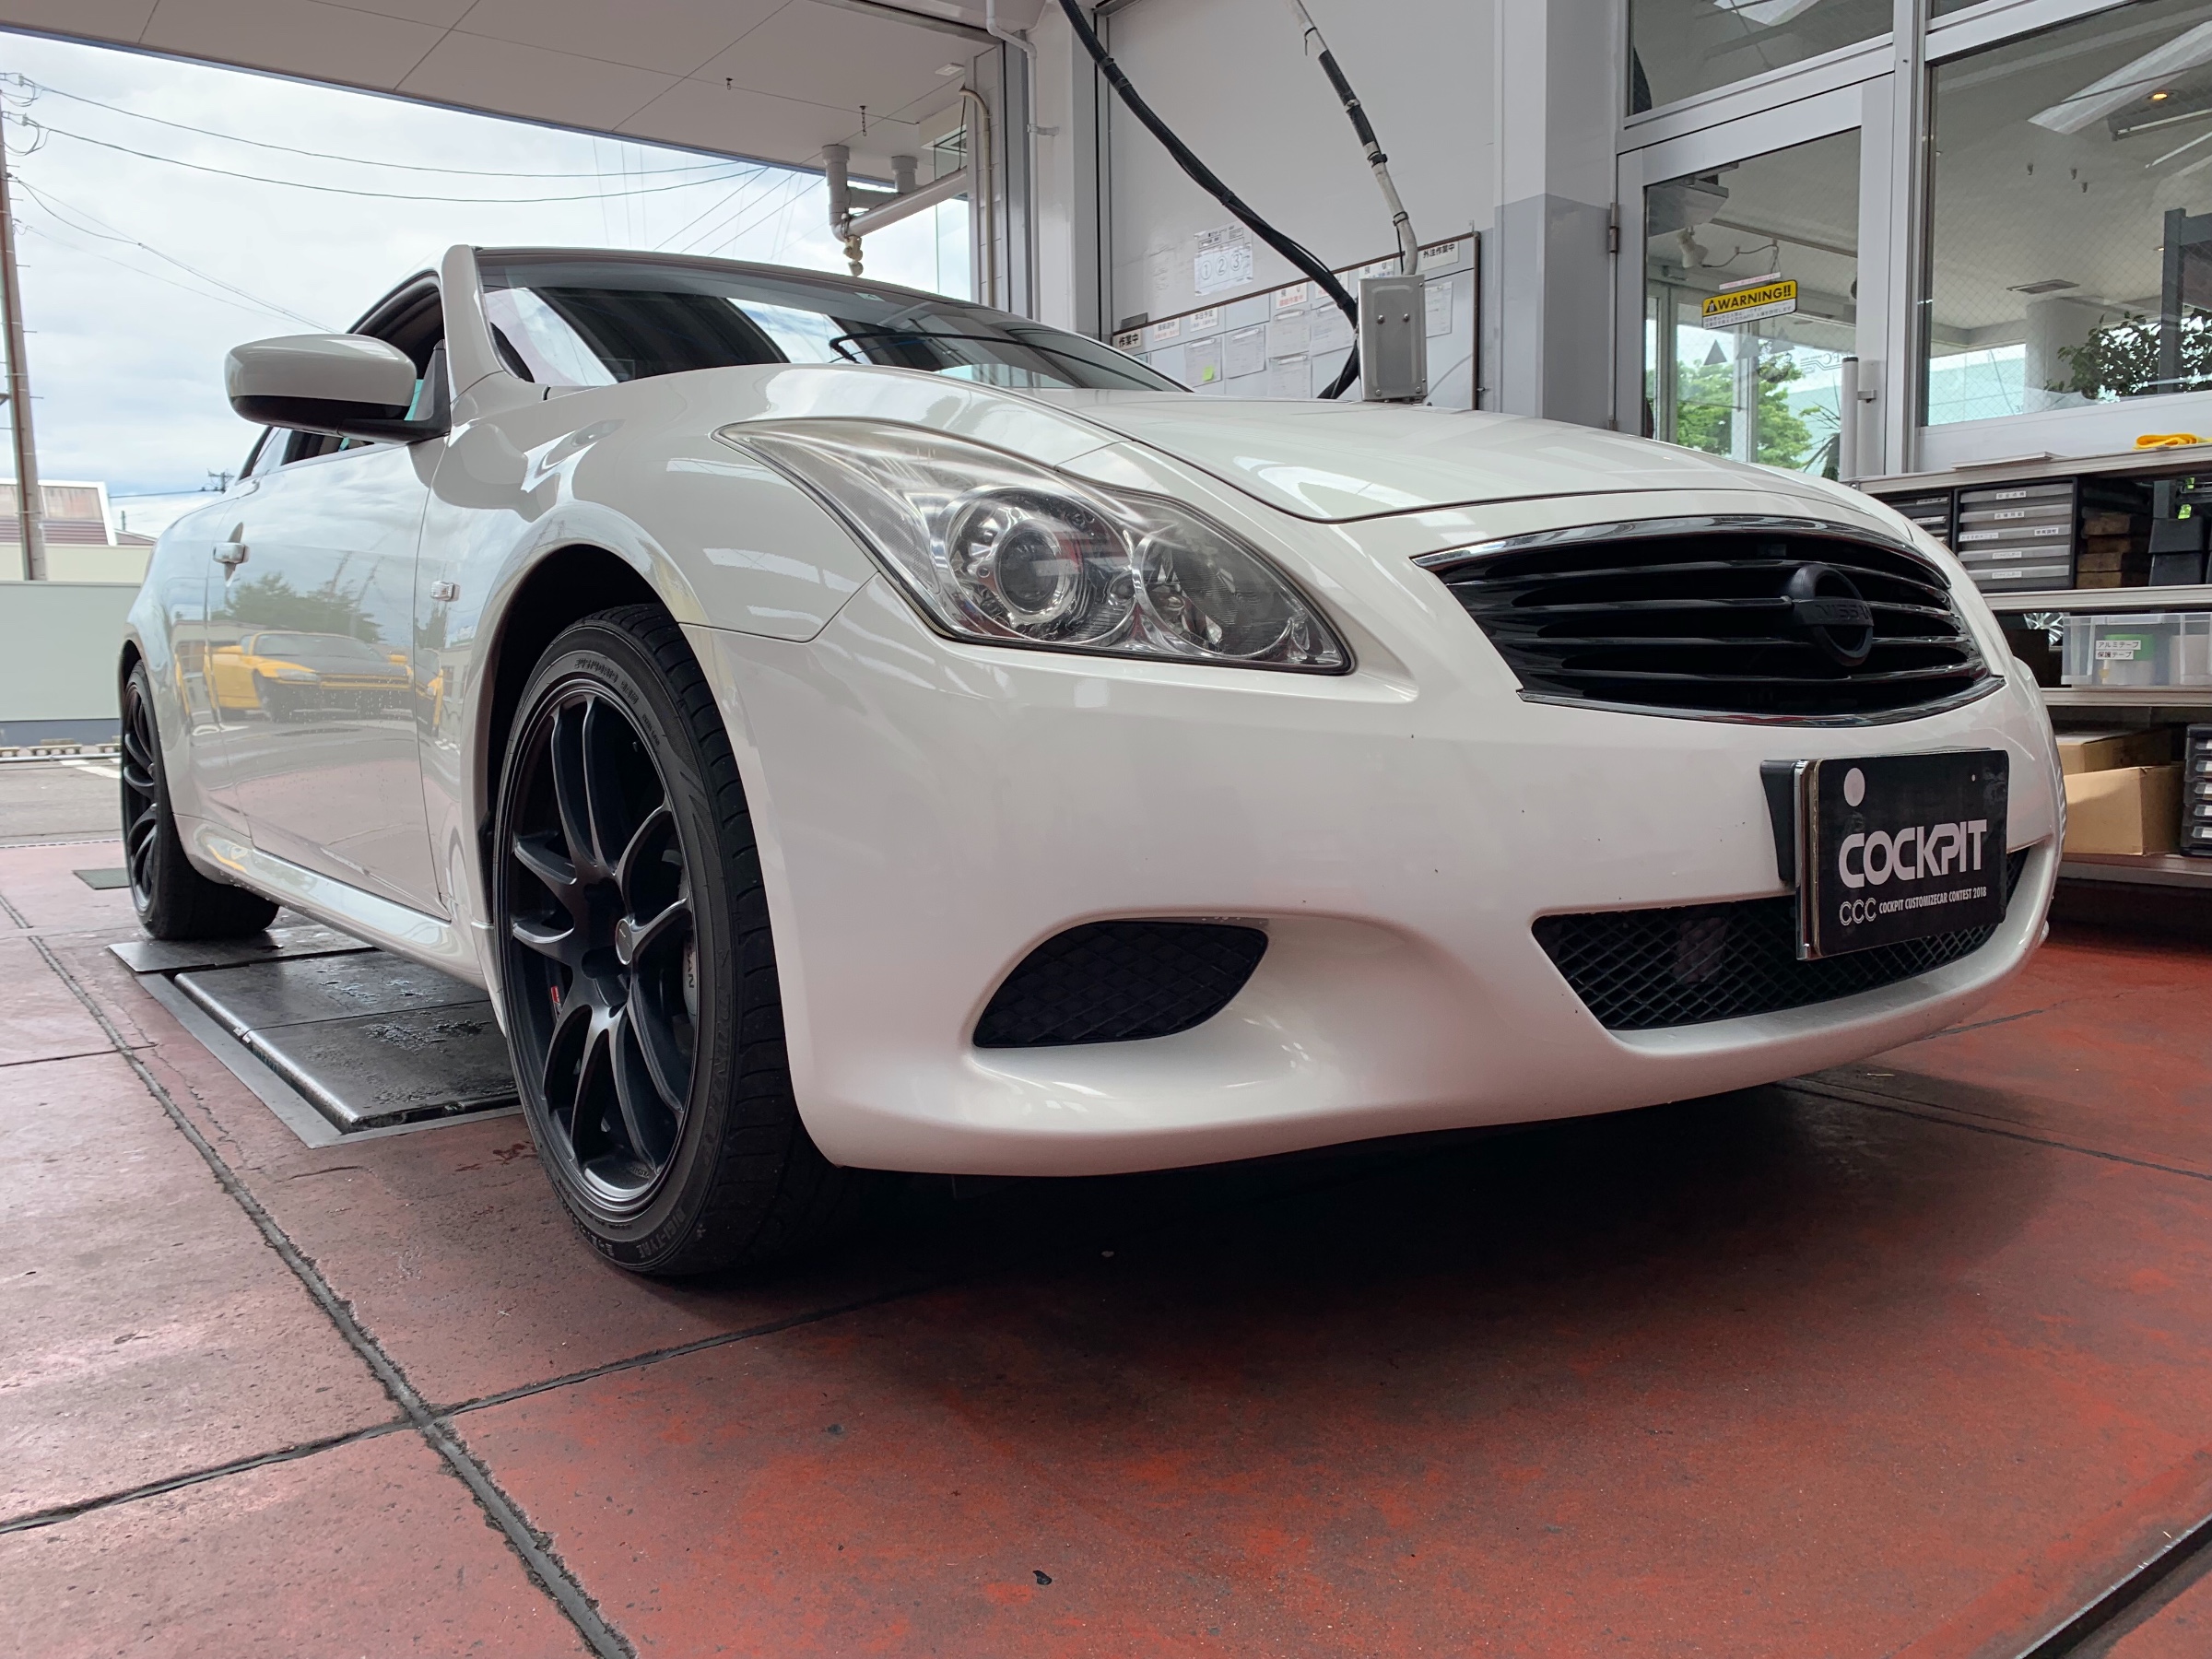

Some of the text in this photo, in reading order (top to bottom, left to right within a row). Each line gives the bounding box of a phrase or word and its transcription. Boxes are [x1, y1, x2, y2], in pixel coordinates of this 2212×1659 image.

[1718, 285, 1791, 311] WARNING!!
[1839, 819, 1987, 888] COCKPIT
[1839, 886, 1987, 926] CCC COCKPIT CUSTOMIZECAR CONTEST 2018
